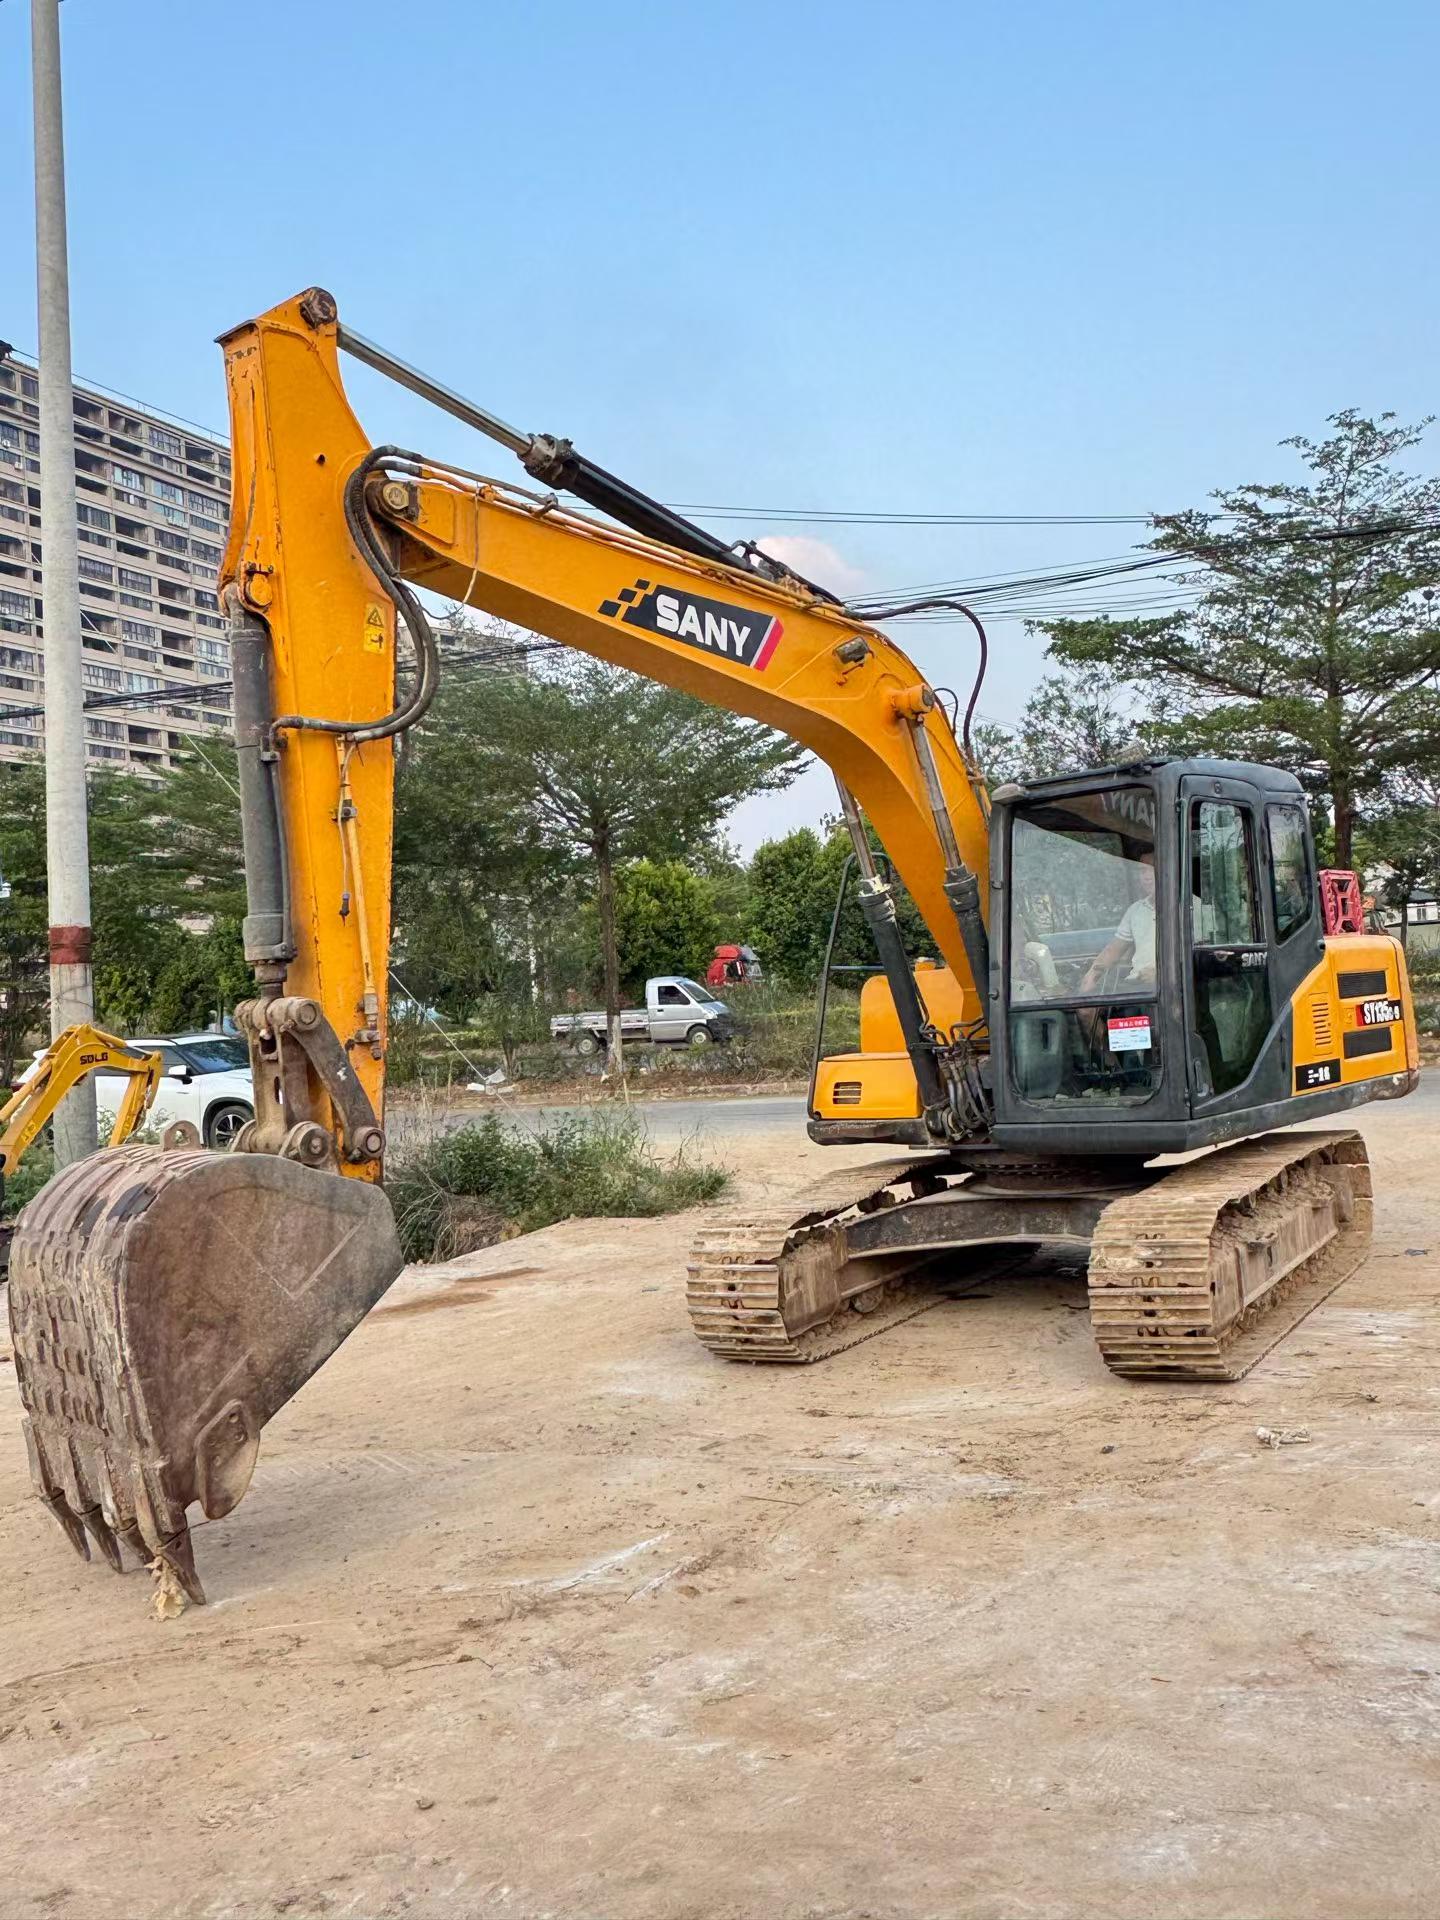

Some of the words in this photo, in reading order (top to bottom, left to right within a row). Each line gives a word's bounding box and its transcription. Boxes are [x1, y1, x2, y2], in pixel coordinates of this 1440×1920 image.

[656, 594, 751, 657] SANY
[1241, 951, 1268, 967] SANY
[80, 1052, 108, 1065] SDLG
